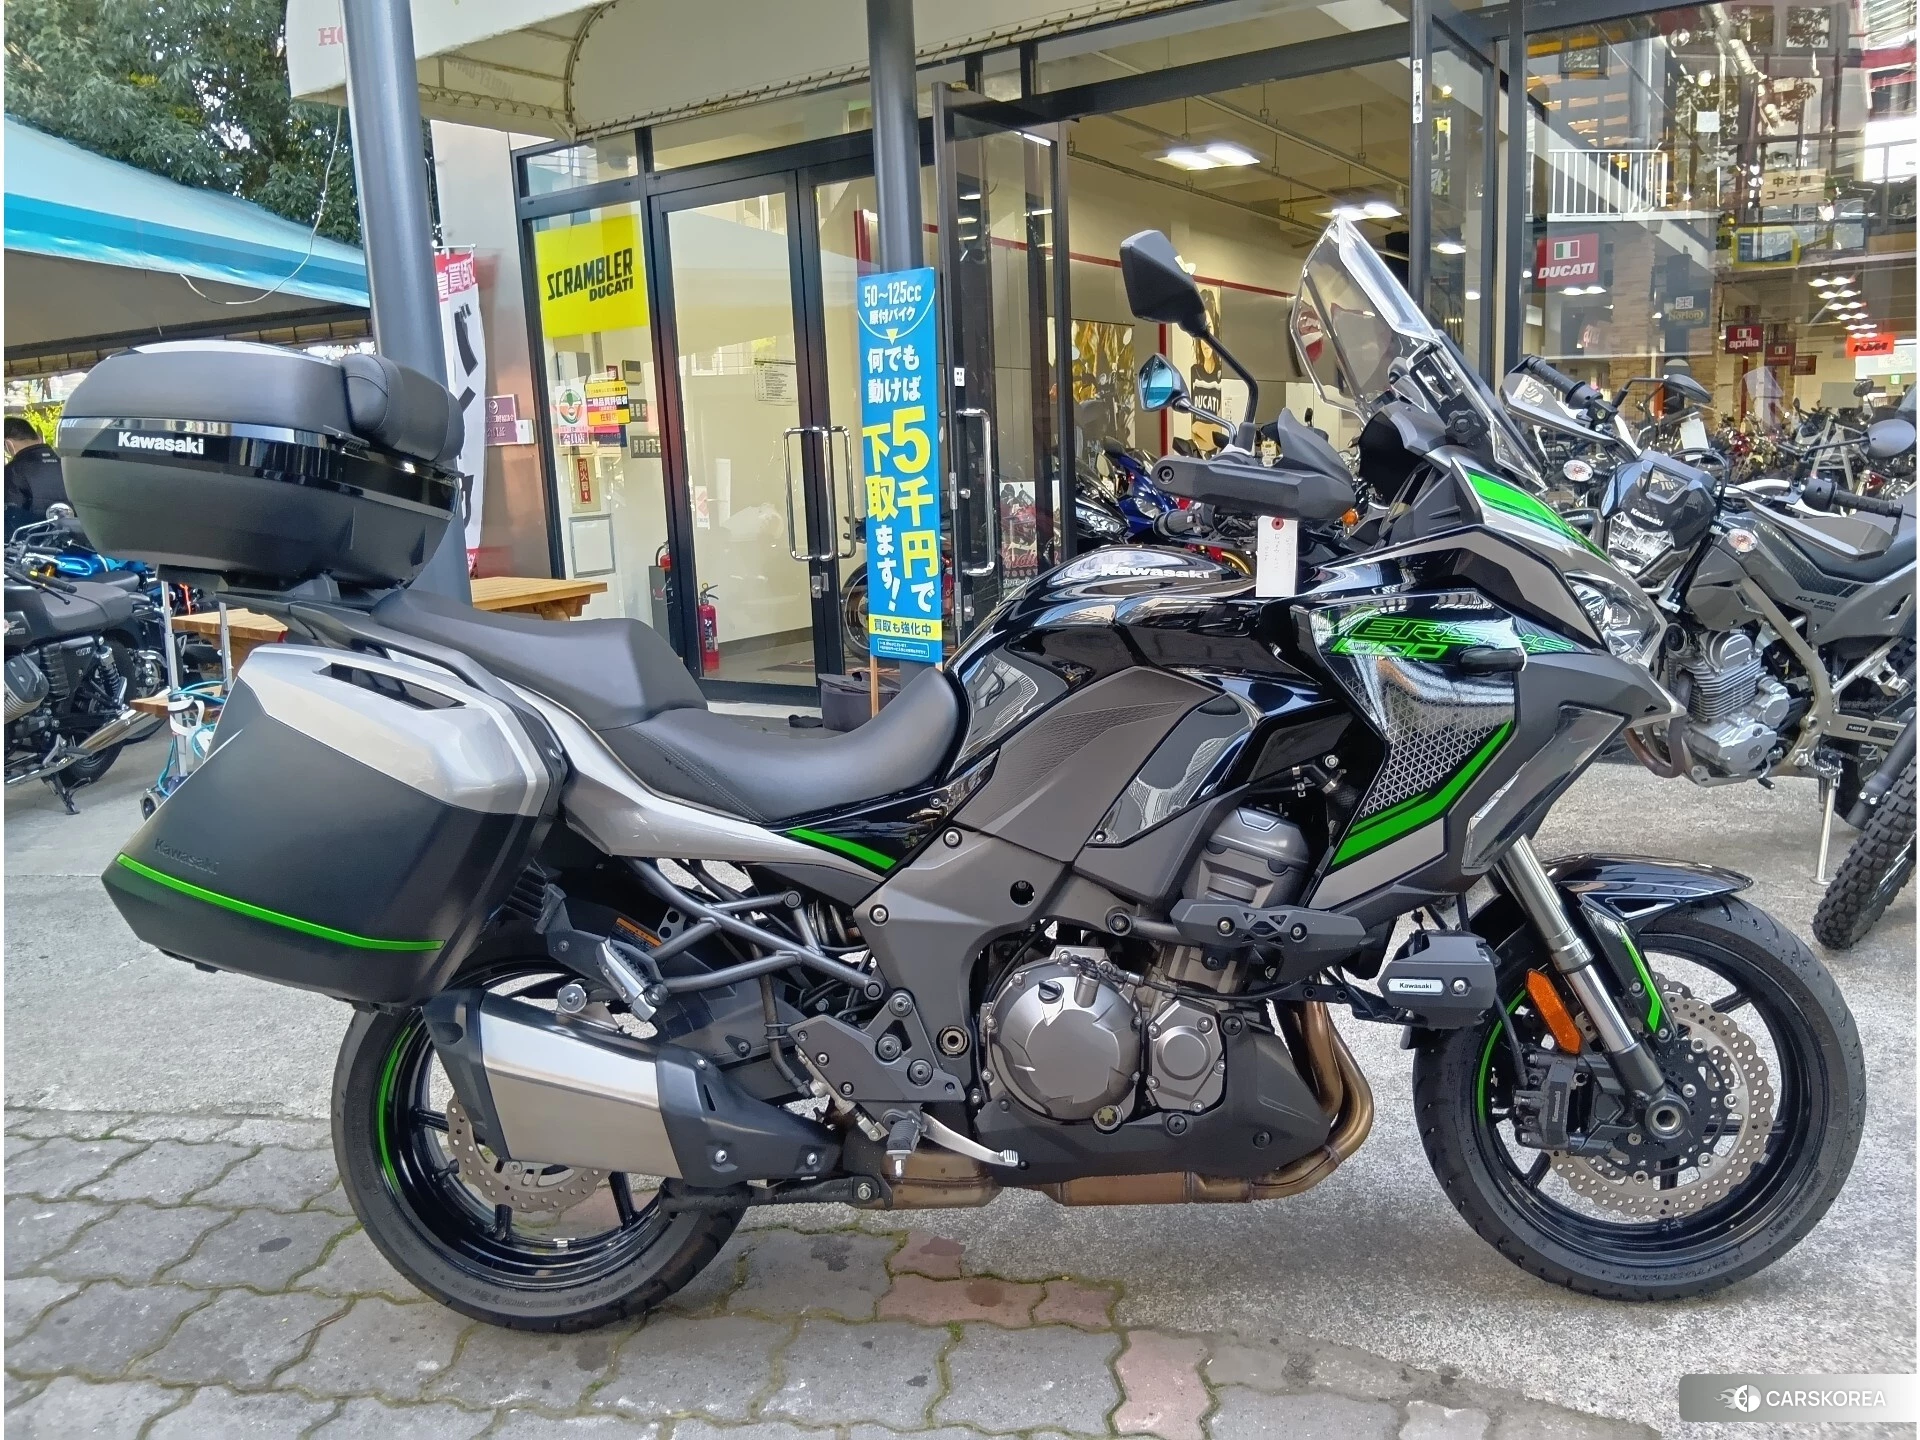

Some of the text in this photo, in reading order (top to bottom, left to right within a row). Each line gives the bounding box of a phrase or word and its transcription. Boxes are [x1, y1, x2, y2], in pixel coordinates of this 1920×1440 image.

[546, 247, 633, 301] SCRAMBLER
[1538, 262, 1596, 279] DUCATI
[589, 275, 634, 302] DUCATI
[869, 306, 916, 325] 原付バイク
[1729, 337, 1759, 350] aprilia
[1853, 341, 1888, 353] KTM
[867, 344, 920, 374] 何でも
[867, 375, 922, 404] 動けば
[118, 431, 204, 455] Kawasaki
[892, 405, 939, 613] 5千円で
[1630, 507, 1664, 527] Kawasaki
[1100, 563, 1210, 579] Kawasaki
[874, 618, 932, 636] 買取も強化中
[154, 838, 220, 875] Kawasaki
